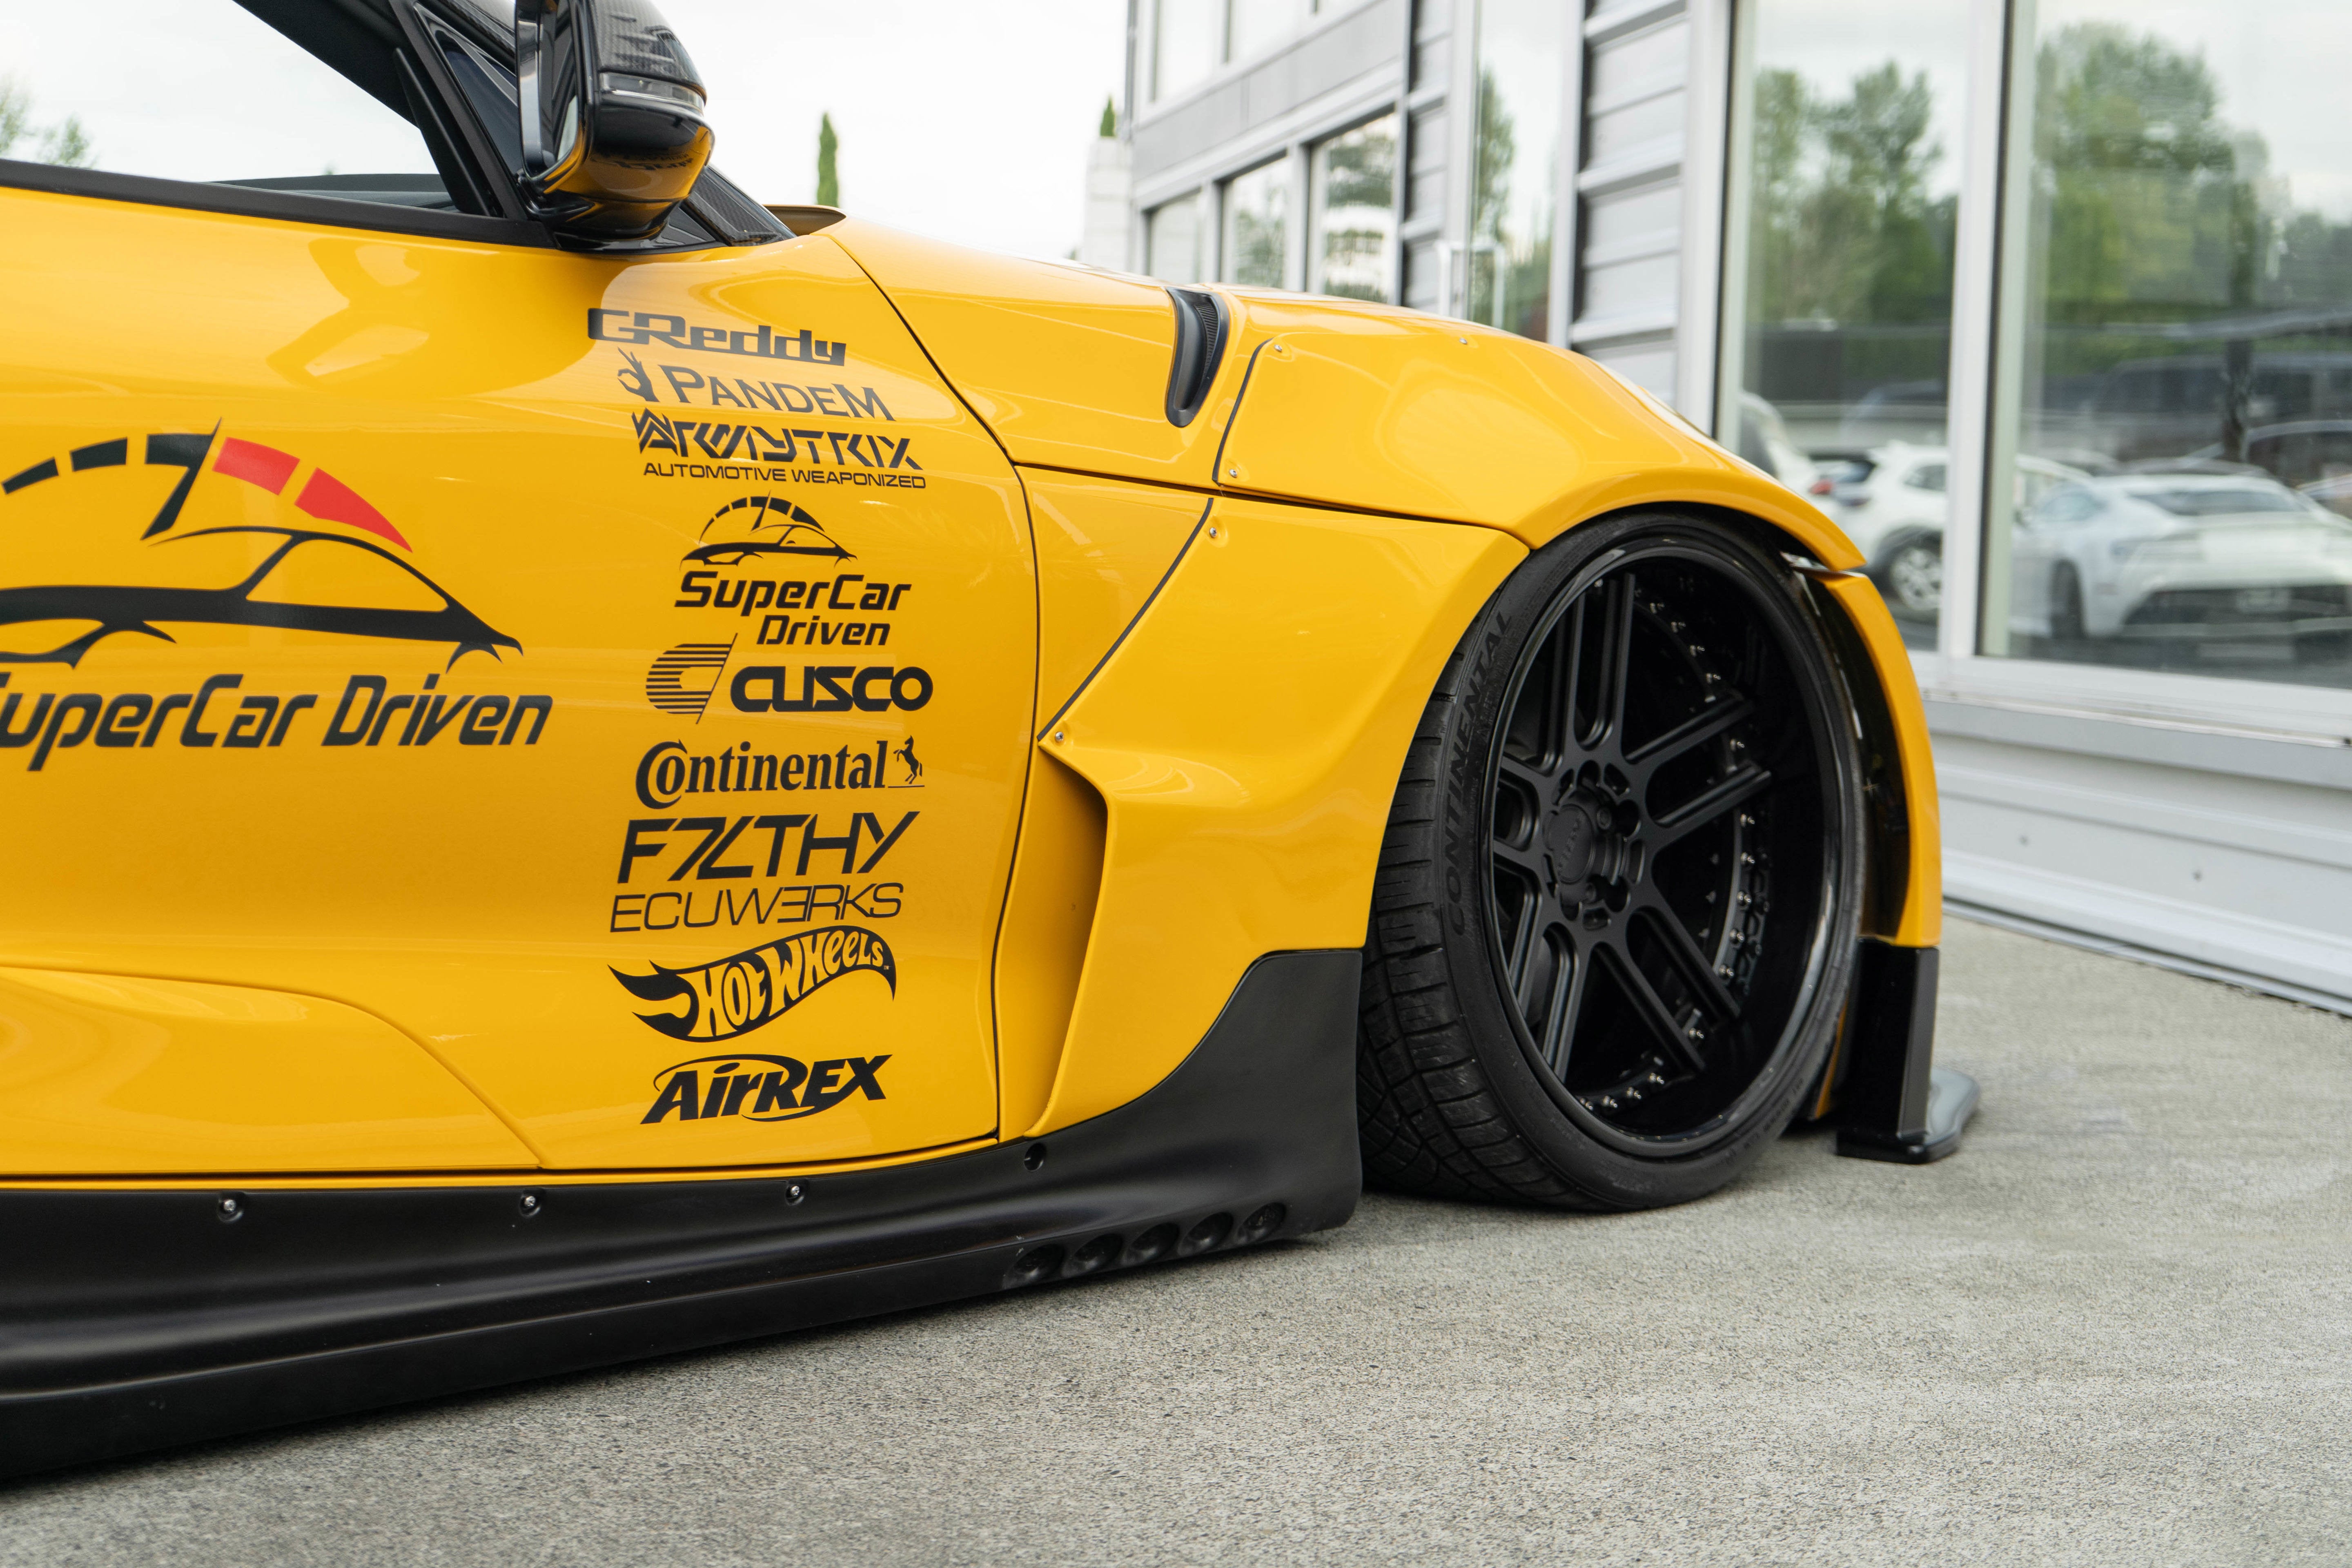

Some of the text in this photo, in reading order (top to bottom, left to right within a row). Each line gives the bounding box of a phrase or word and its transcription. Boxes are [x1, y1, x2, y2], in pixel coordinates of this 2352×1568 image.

[587, 307, 846, 366] GReddy
[658, 364, 896, 422] PANDEM
[644, 462, 926, 489] AUTOMOTIVE WEAPONIZED
[675, 571, 912, 617] SuperCar
[757, 615, 890, 645] Driven
[730, 666, 934, 713] CUSCO
[0, 672, 553, 771] uperCar Driven
[635, 739, 889, 809] Continental
